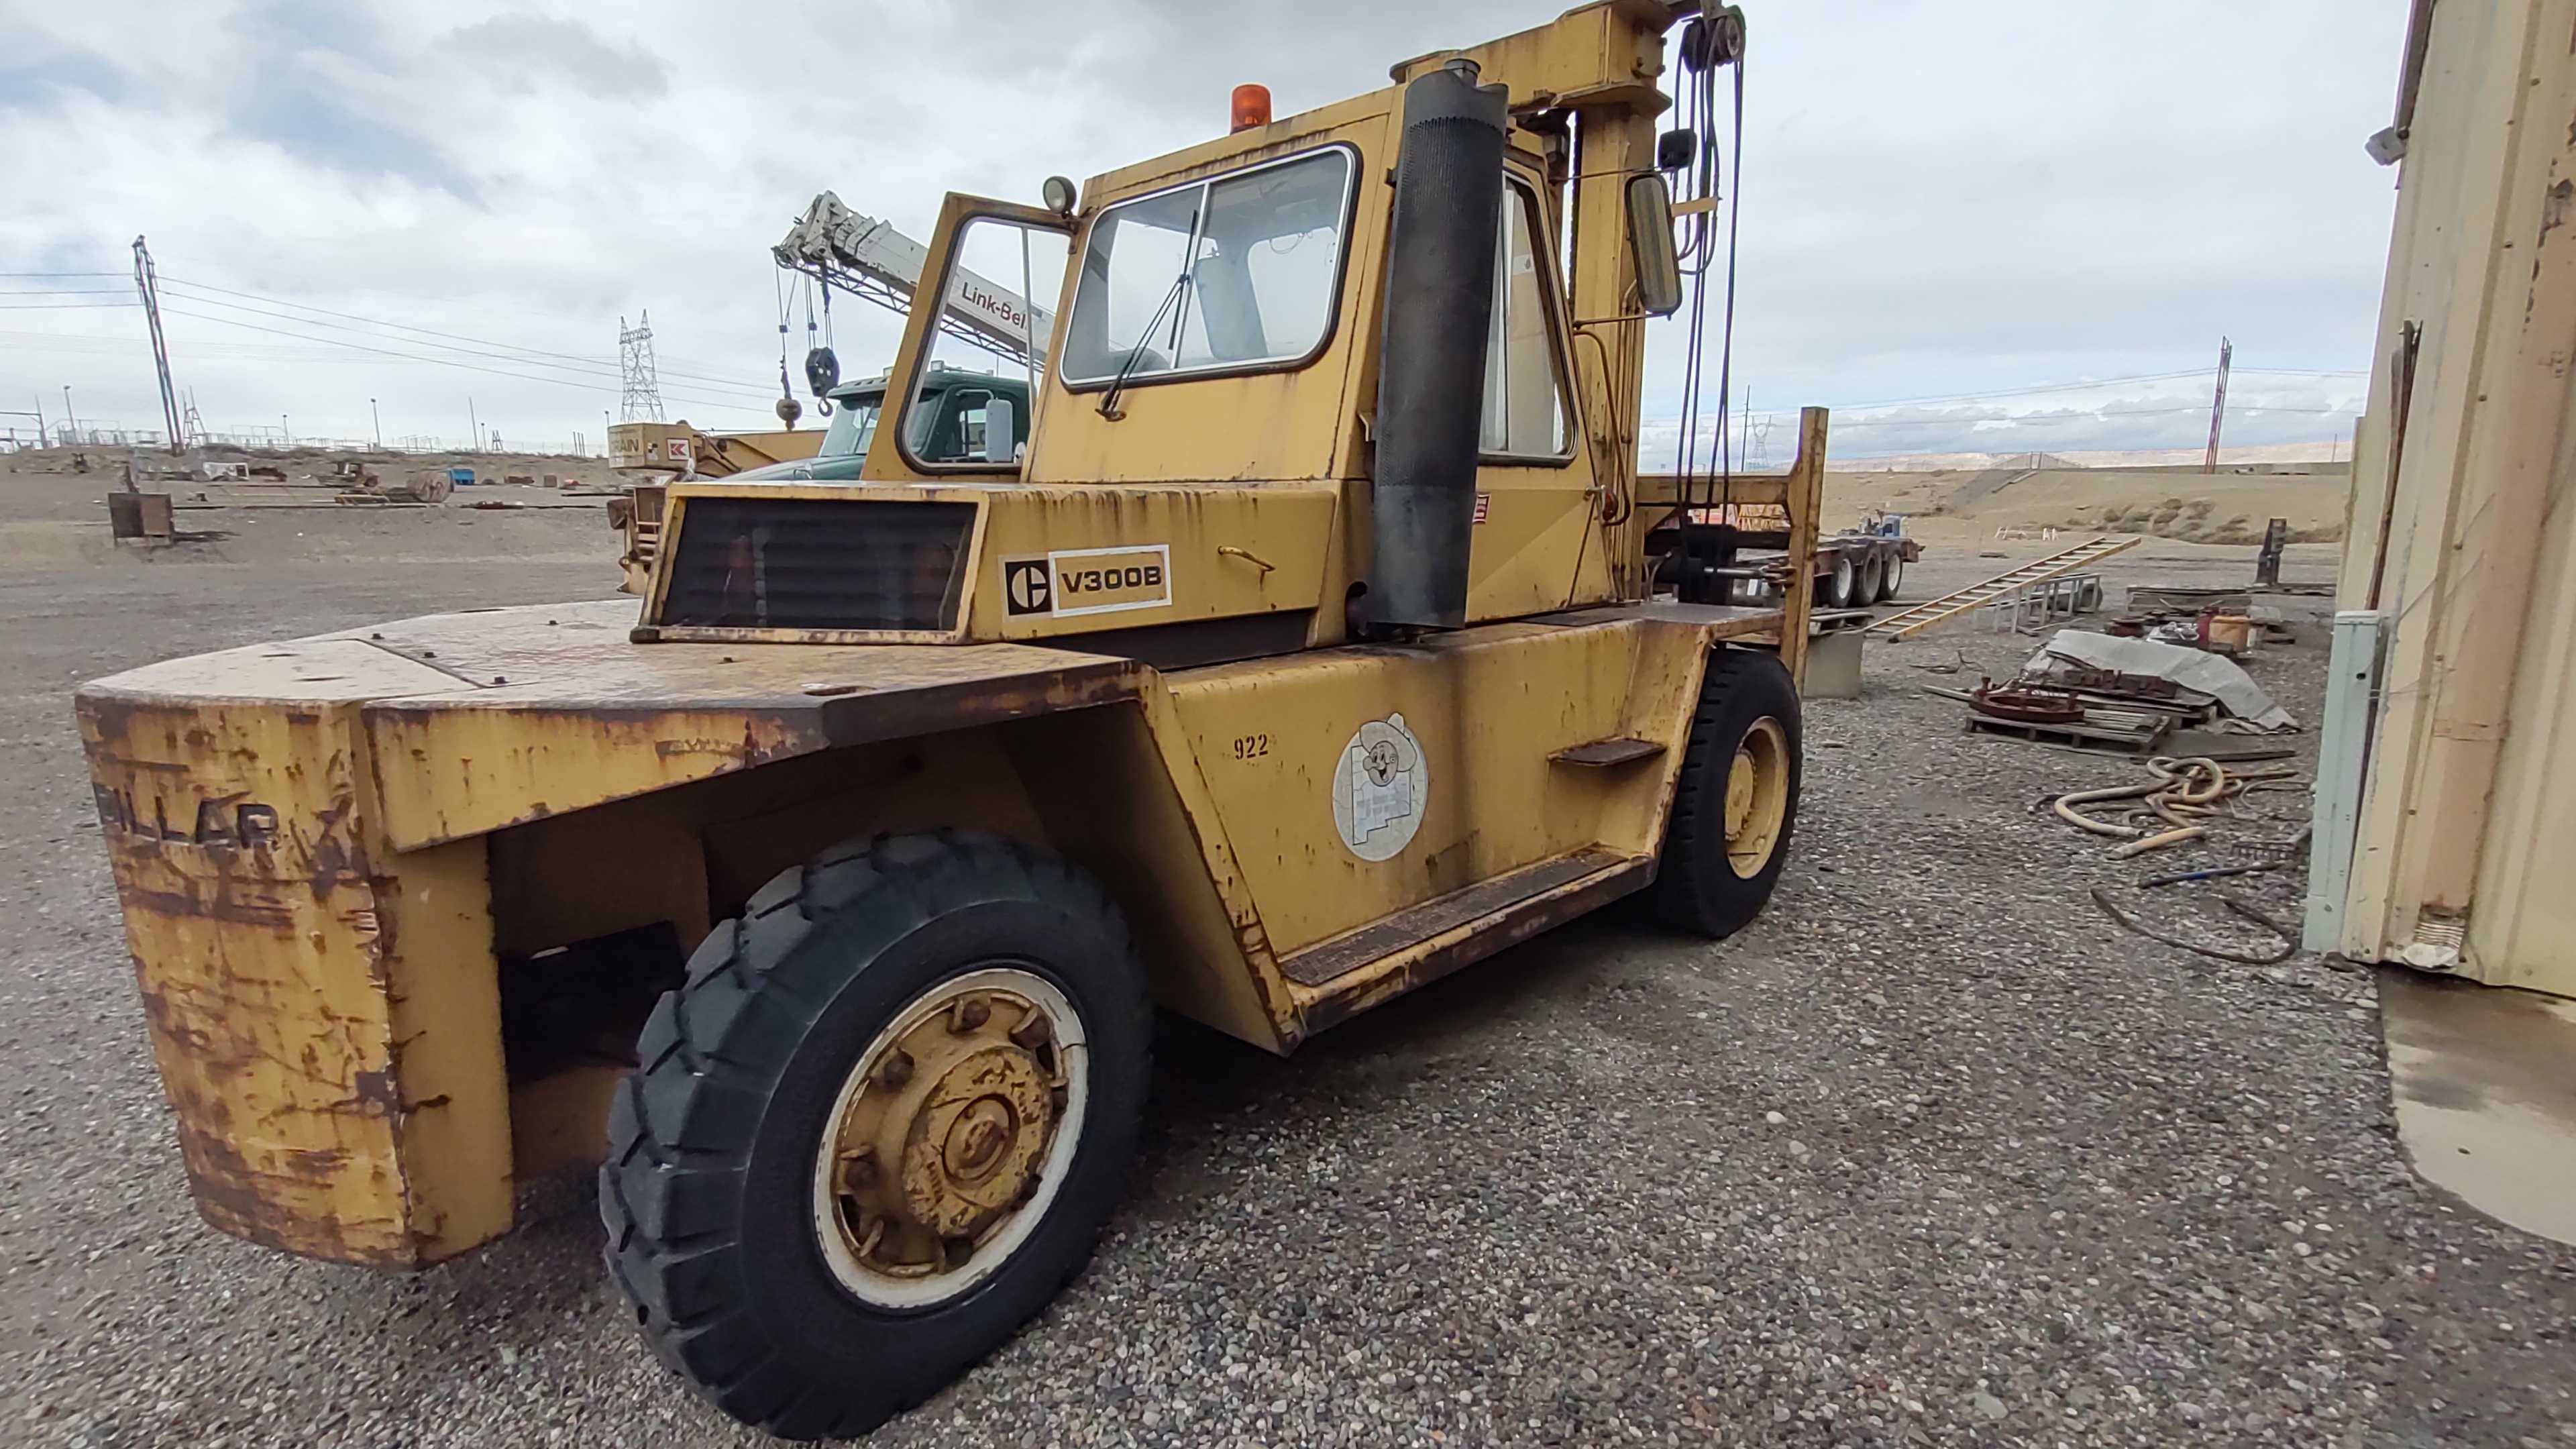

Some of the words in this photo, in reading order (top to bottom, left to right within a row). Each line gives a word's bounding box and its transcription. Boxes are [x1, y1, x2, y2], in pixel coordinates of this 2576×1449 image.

[961, 281, 1028, 330] Link-Bel
[1061, 565, 1163, 594] V300B
[1234, 733, 1269, 760] 922
